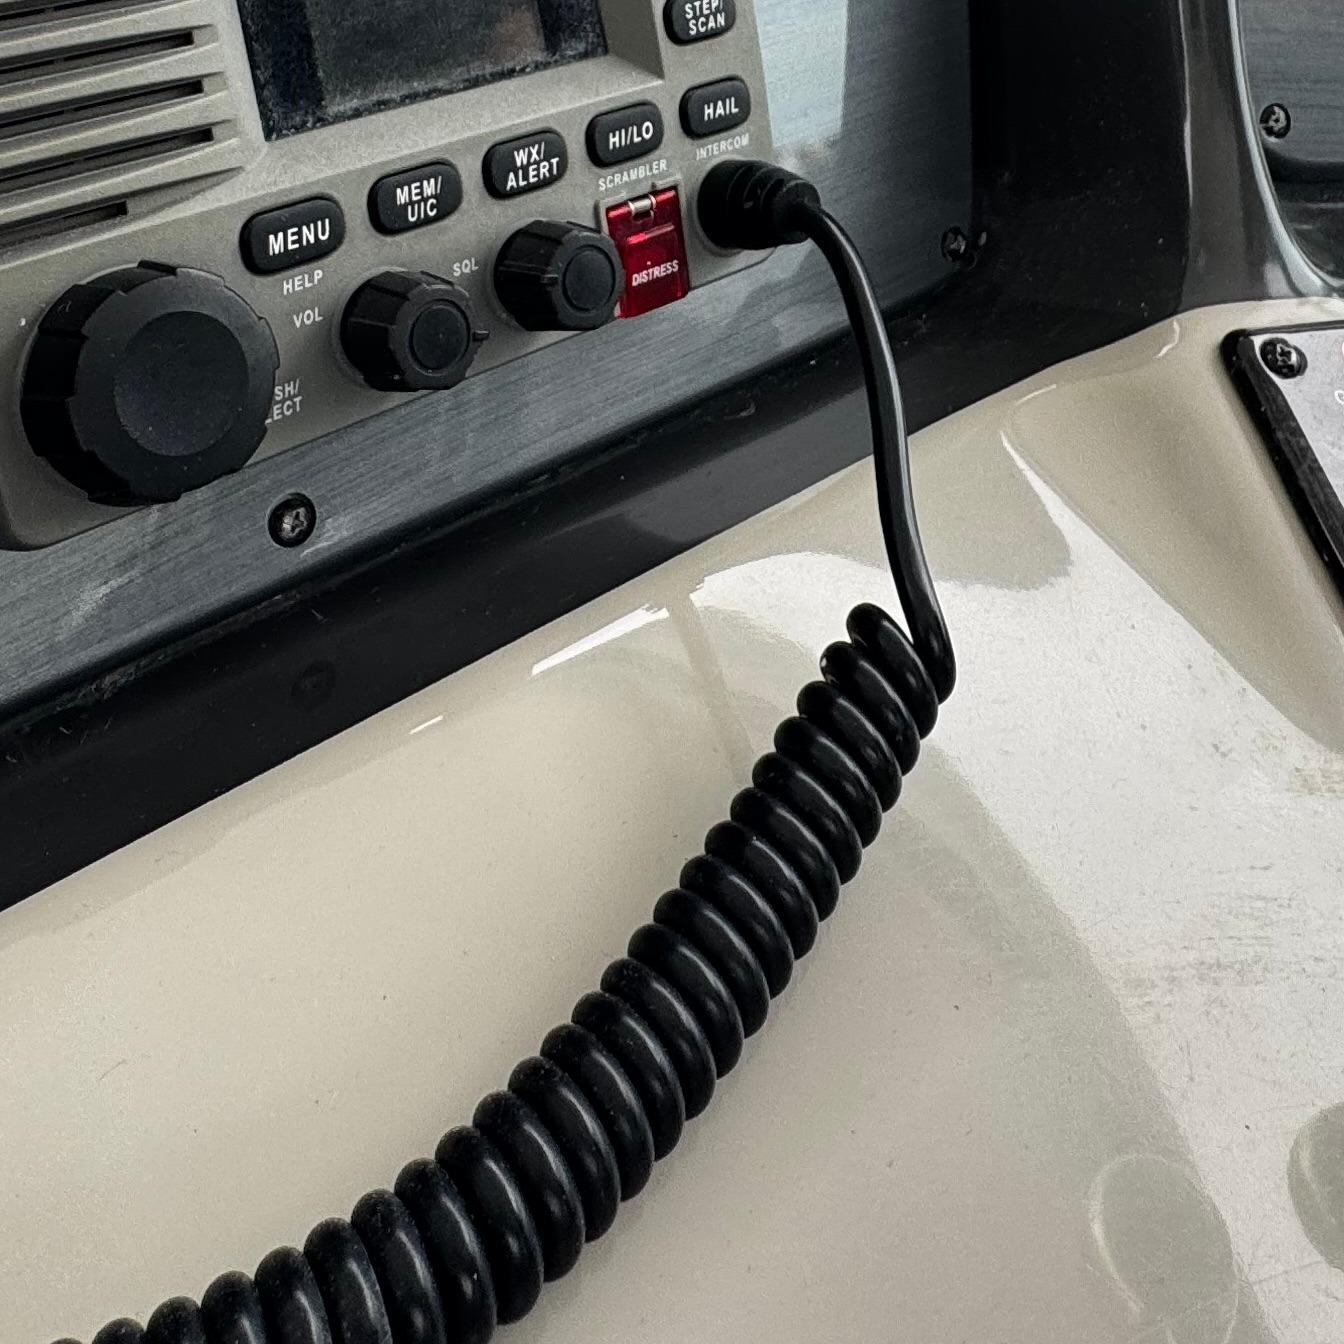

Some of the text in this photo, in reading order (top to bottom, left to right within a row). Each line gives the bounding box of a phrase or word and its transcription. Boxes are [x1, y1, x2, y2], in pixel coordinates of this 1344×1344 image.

[688, 12, 726, 36] SCAN
[704, 96, 740, 122] HAIL
[608, 120, 654, 151] HI/LO
[696, 132, 750, 161] INTERCOM
[514, 141, 545, 168] WX/
[506, 157, 560, 192] ALERT
[598, 159, 669, 191] SCRAMBLER
[396, 176, 442, 206] MEM/
[407, 198, 438, 223] UIC
[268, 217, 331, 256] MENU
[452, 256, 480, 278] SQL
[631, 259, 679, 287] DISTRESS
[283, 269, 324, 296] HELP
[293, 307, 324, 329] VOL
